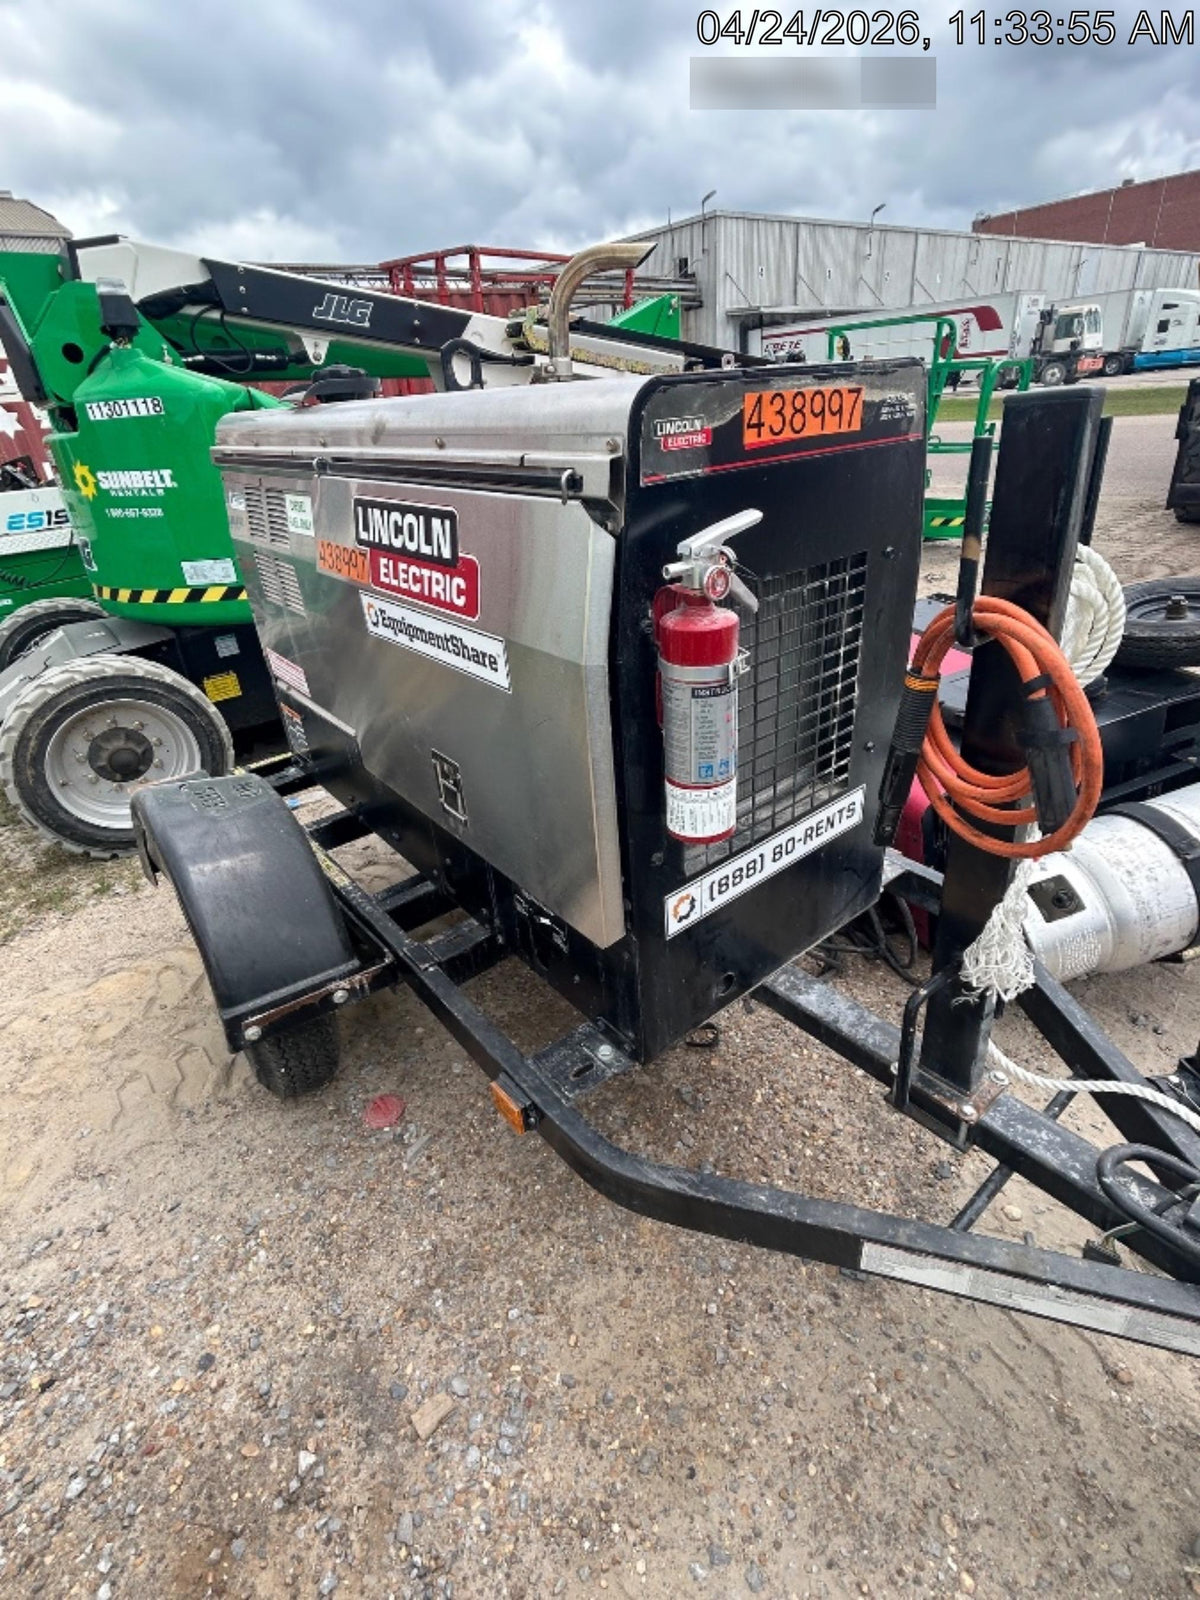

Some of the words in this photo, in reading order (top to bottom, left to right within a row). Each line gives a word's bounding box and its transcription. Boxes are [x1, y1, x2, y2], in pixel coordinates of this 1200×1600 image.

[312, 293, 374, 327] JLG
[88, 398, 163, 419] 11301118
[657, 419, 702, 436] LINCOLN
[746, 387, 863, 439] 438997
[667, 433, 707, 447] ELECTRIC
[96, 469, 174, 489] SUNBELT
[356, 506, 452, 560] LINCOLN
[319, 540, 368, 581] 438997
[379, 557, 467, 608] ELECTRIC
[378, 609, 499, 673] EquipmentShare
[708, 853, 764, 902] (888)
